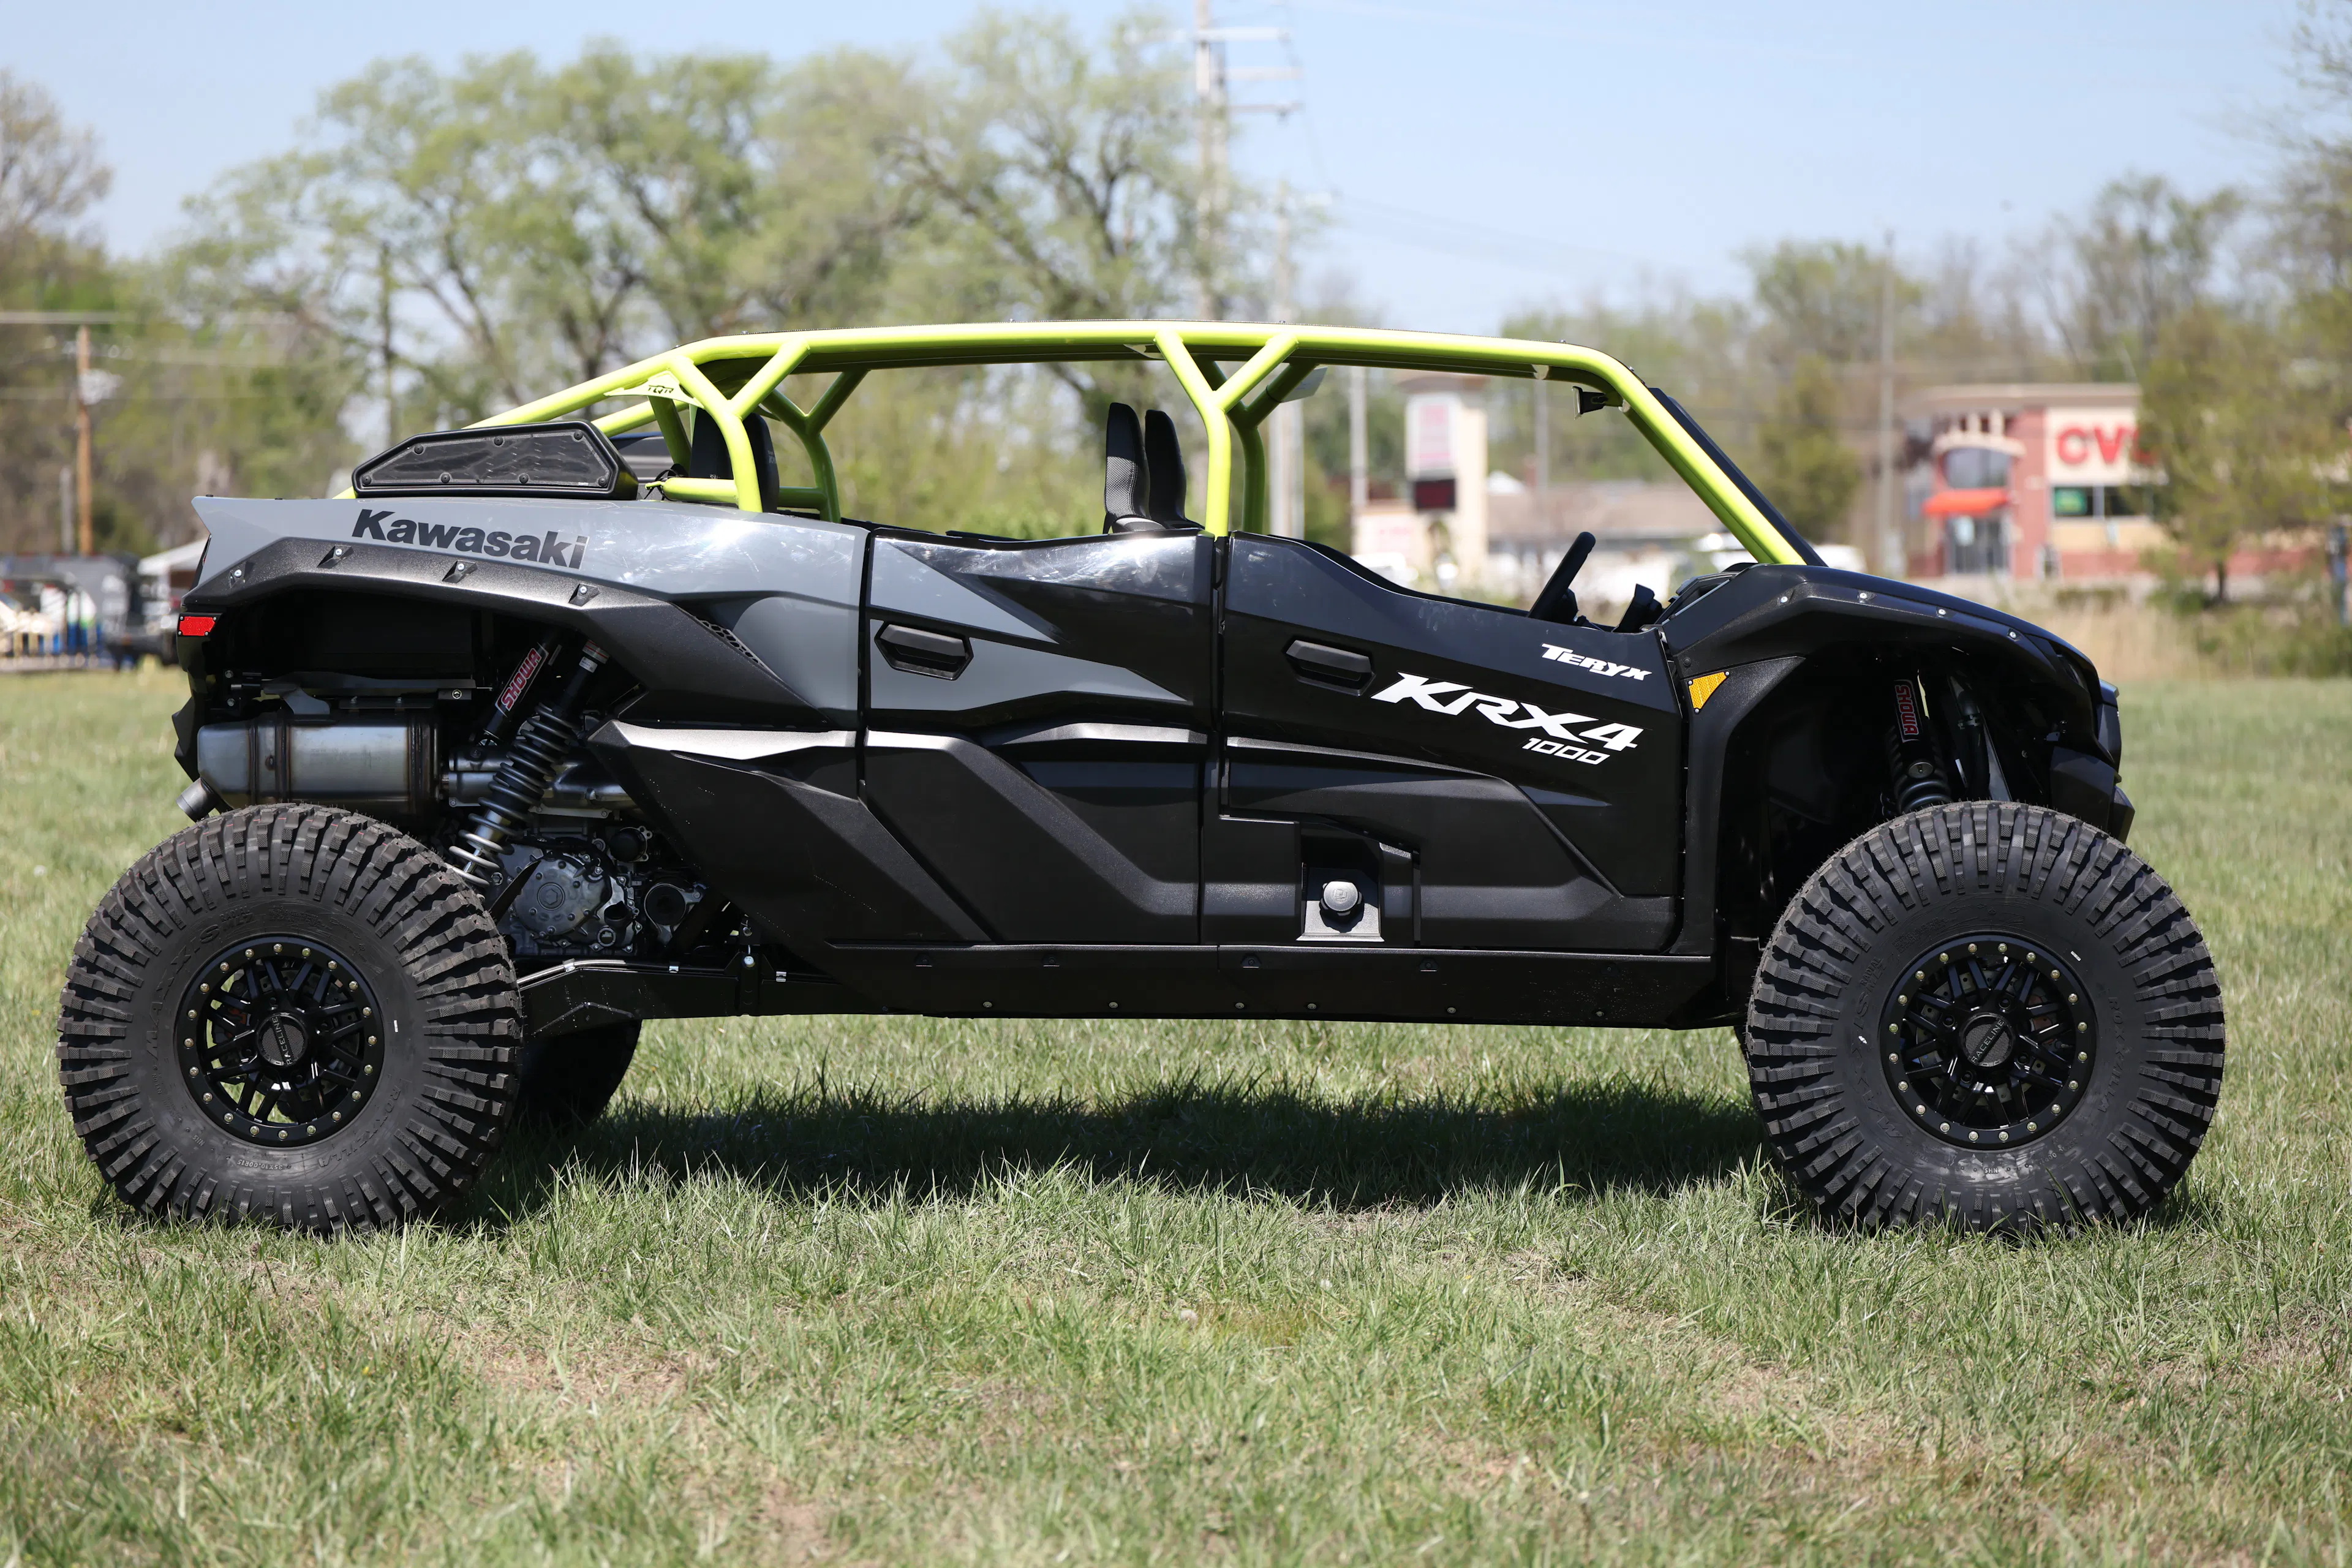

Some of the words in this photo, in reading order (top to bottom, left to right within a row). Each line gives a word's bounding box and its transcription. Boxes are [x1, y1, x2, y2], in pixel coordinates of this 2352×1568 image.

[352, 509, 590, 570] Kawasaki
[501, 647, 542, 712] SHOWA
[1370, 671, 1644, 752] KRX4
[1895, 685, 1919, 735] SHOWA
[1522, 737, 1611, 765] 1000
[272, 1016, 293, 1065] RACELINE
[1971, 1019, 2005, 1064] RACELINE
[192, 1134, 205, 1147] NHS
[237, 1159, 283, 1170] 35X10.00R15
